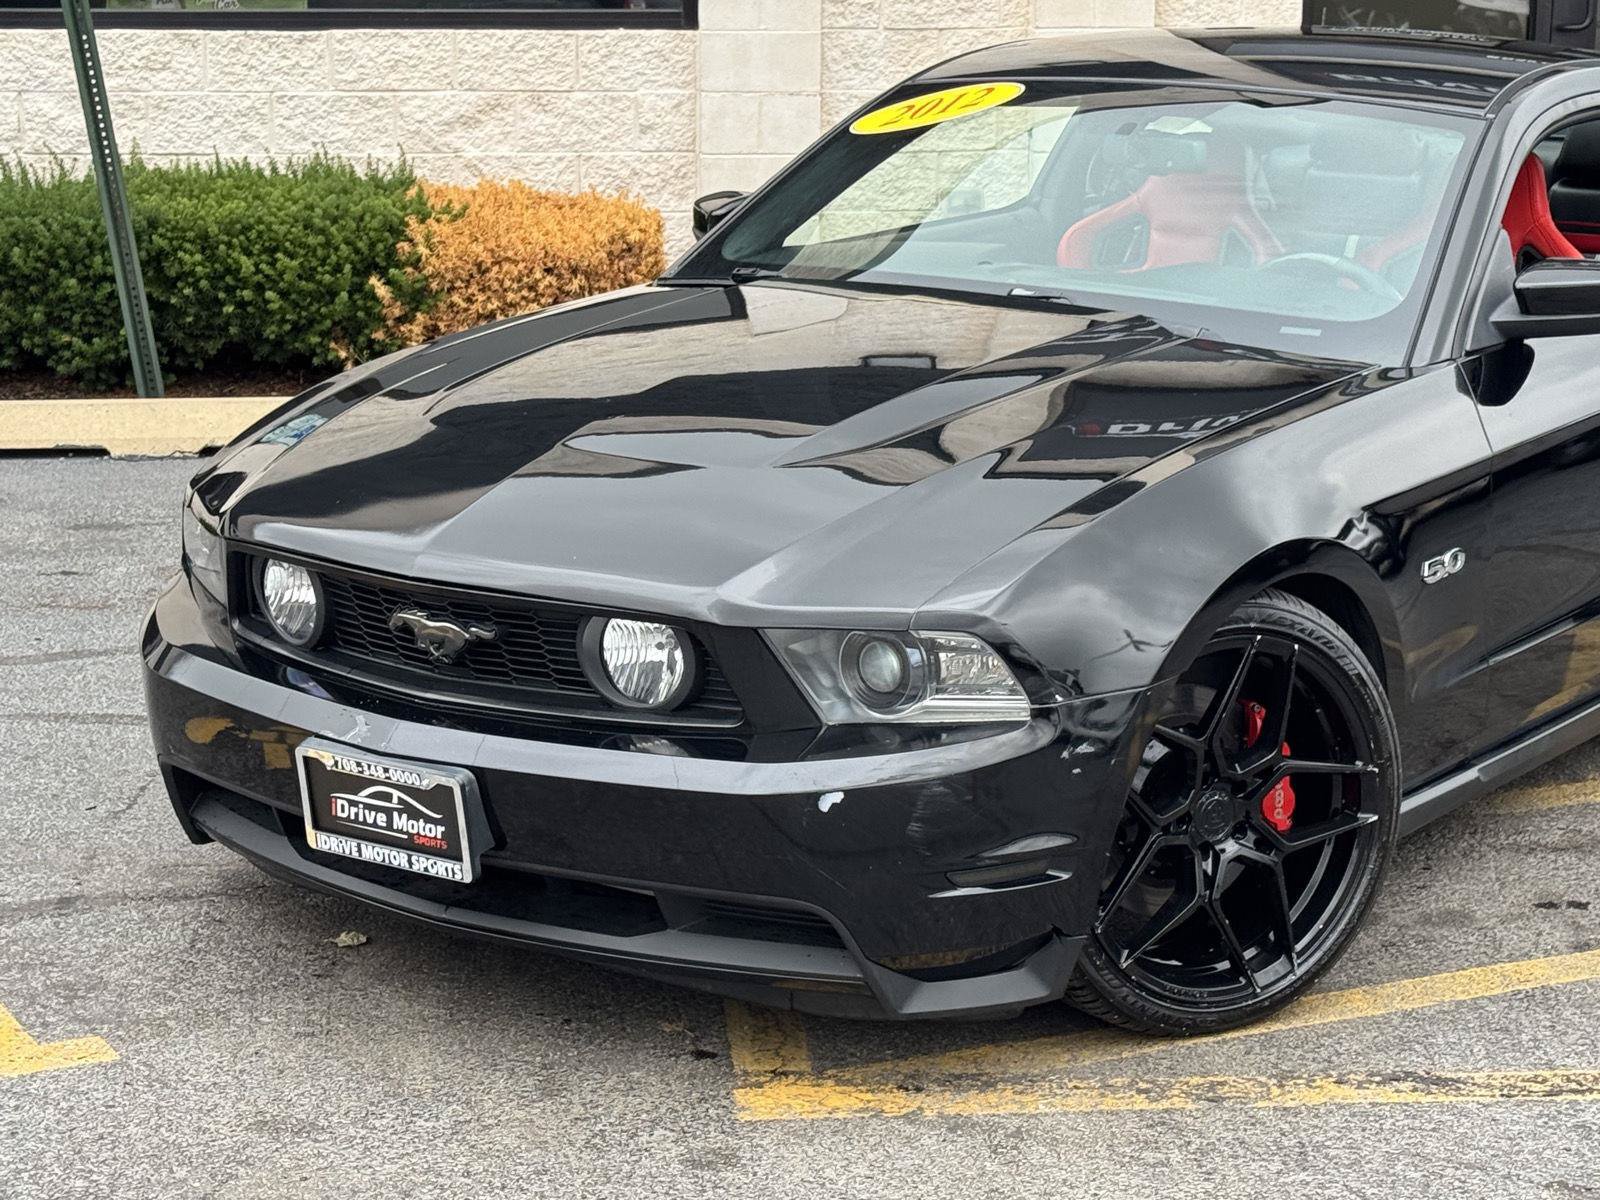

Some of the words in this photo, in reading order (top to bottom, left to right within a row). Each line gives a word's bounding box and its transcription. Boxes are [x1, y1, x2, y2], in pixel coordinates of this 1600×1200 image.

[878, 87, 996, 128] 2012
[1420, 547, 1466, 584] 5.0
[334, 757, 421, 786] 708-348-0000
[331, 797, 388, 827] iDrive
[392, 811, 446, 839] Motor
[413, 833, 448, 850] SPORTS
[360, 844, 409, 869] MOTOR
[410, 854, 463, 880] SPORTS
